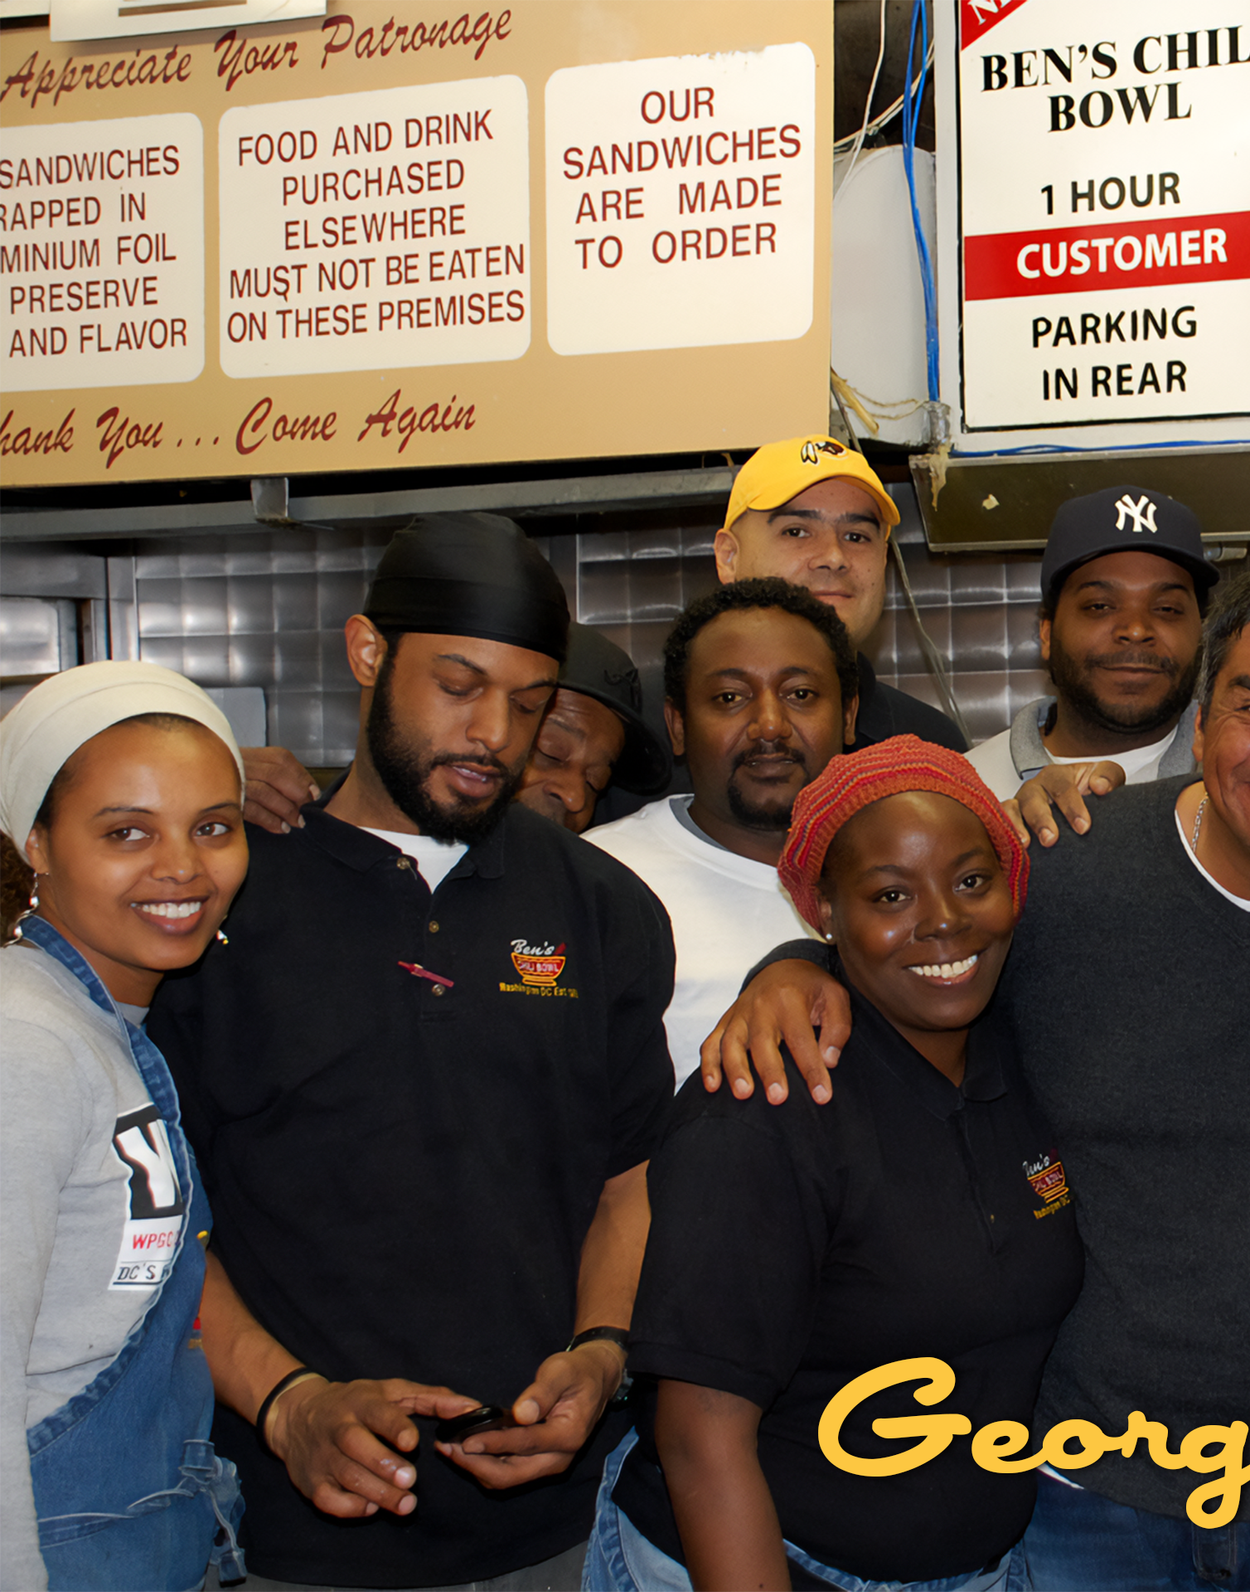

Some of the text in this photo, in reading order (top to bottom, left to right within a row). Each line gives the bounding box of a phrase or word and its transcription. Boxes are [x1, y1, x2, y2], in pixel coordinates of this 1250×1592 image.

[0, 9, 512, 109] Appreciate Your Patronage
[980, 41, 1118, 92] BEN’S
[641, 87, 715, 124] OUR
[1047, 81, 1192, 133] BOWL
[238, 109, 493, 166] FOOD AND DRINK
[563, 124, 801, 180] SANDWICHES
[282, 158, 465, 206] PURCHASED
[575, 173, 782, 224] ARE MADE
[1041, 172, 1181, 215] 1 HOUR
[121, 192, 145, 222] IN
[285, 204, 466, 250] ELSEWHERE
[0, 232, 176, 274] MINIUM FOIL
[575, 222, 777, 269] TO ORDER
[1016, 227, 1228, 279] CUSTOMER
[10, 276, 158, 314] PRESERVE
[230, 244, 524, 300] MUST NOT BE EATEN
[9, 318, 187, 358] AND FLAVOR
[227, 290, 525, 343] ON THESE PREMISES
[1032, 305, 1197, 349] PARKING
[1043, 360, 1187, 401] IN REAR
[236, 397, 337, 455] Come
[357, 388, 475, 453] Again
